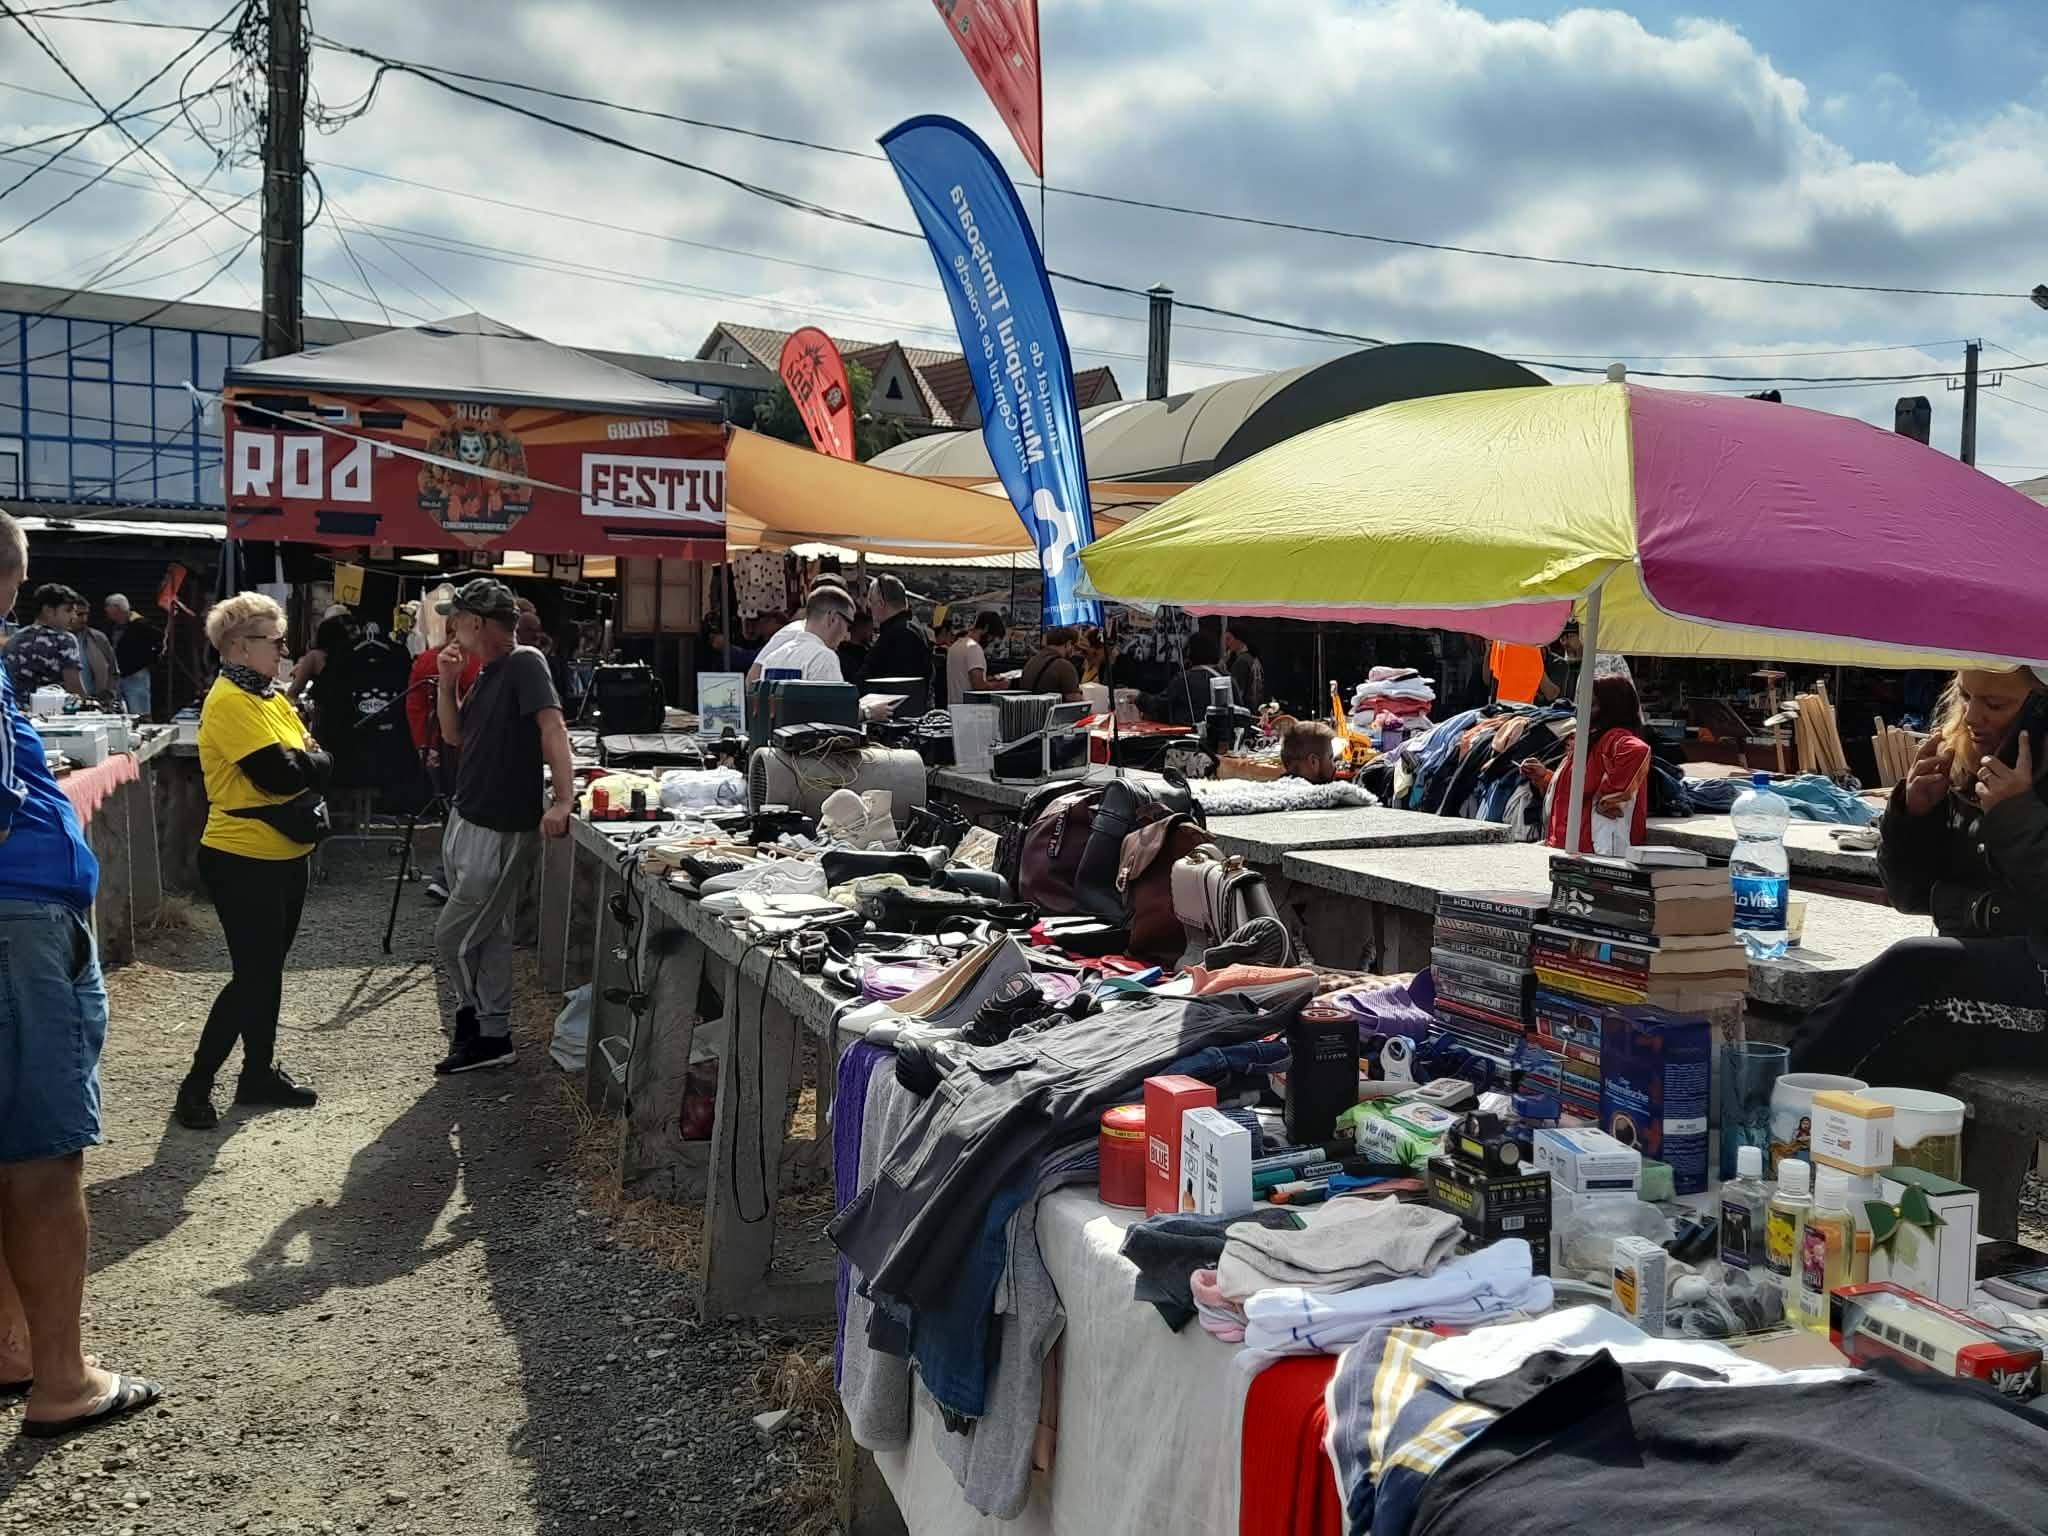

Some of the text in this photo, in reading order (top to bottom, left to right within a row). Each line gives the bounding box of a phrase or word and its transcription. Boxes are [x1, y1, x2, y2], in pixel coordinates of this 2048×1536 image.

[608, 420, 670, 440] GRATIS!
[1495, 905, 1522, 916] KAHN
[1151, 1146, 1168, 1171] BLUE
